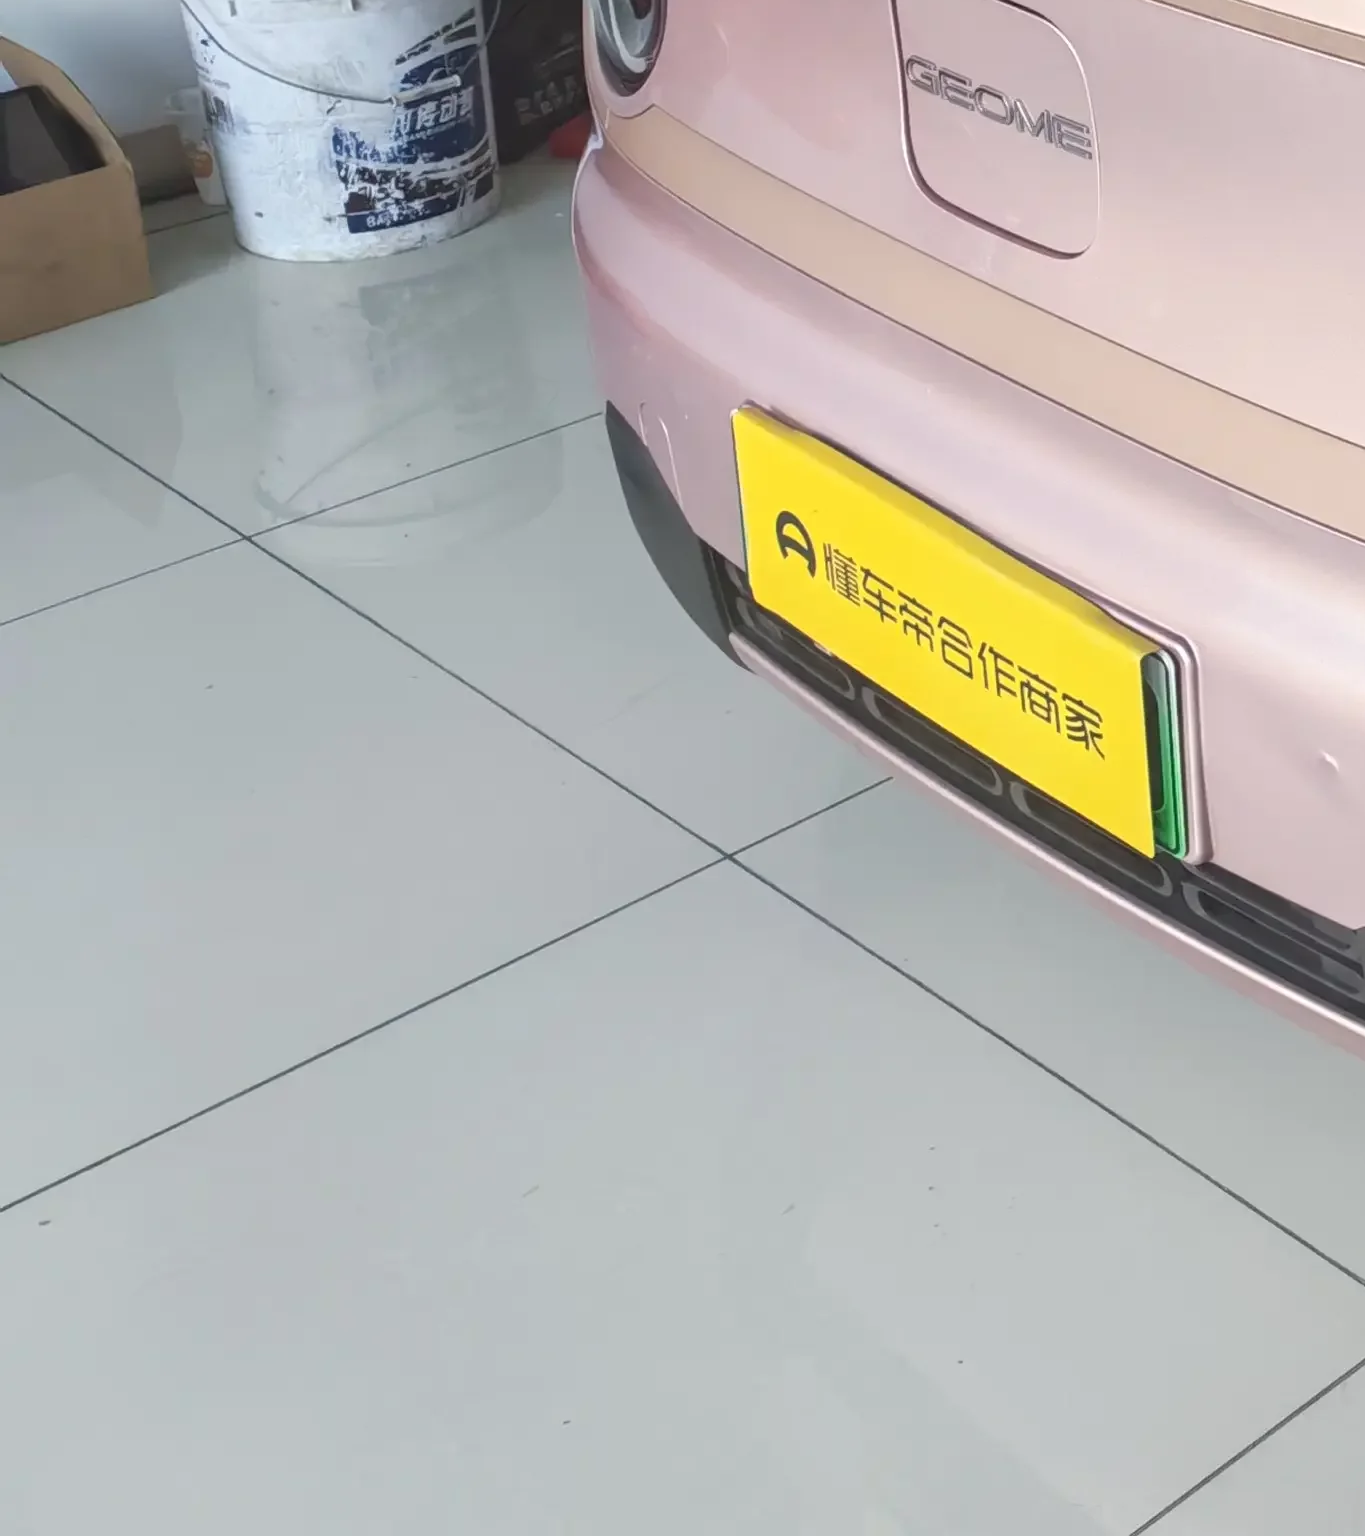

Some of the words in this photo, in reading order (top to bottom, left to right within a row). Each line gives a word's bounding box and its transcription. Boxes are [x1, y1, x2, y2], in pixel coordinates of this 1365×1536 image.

[906, 54, 1093, 160] GEOME
[823, 542, 1105, 761] 懂车帝合作商家
